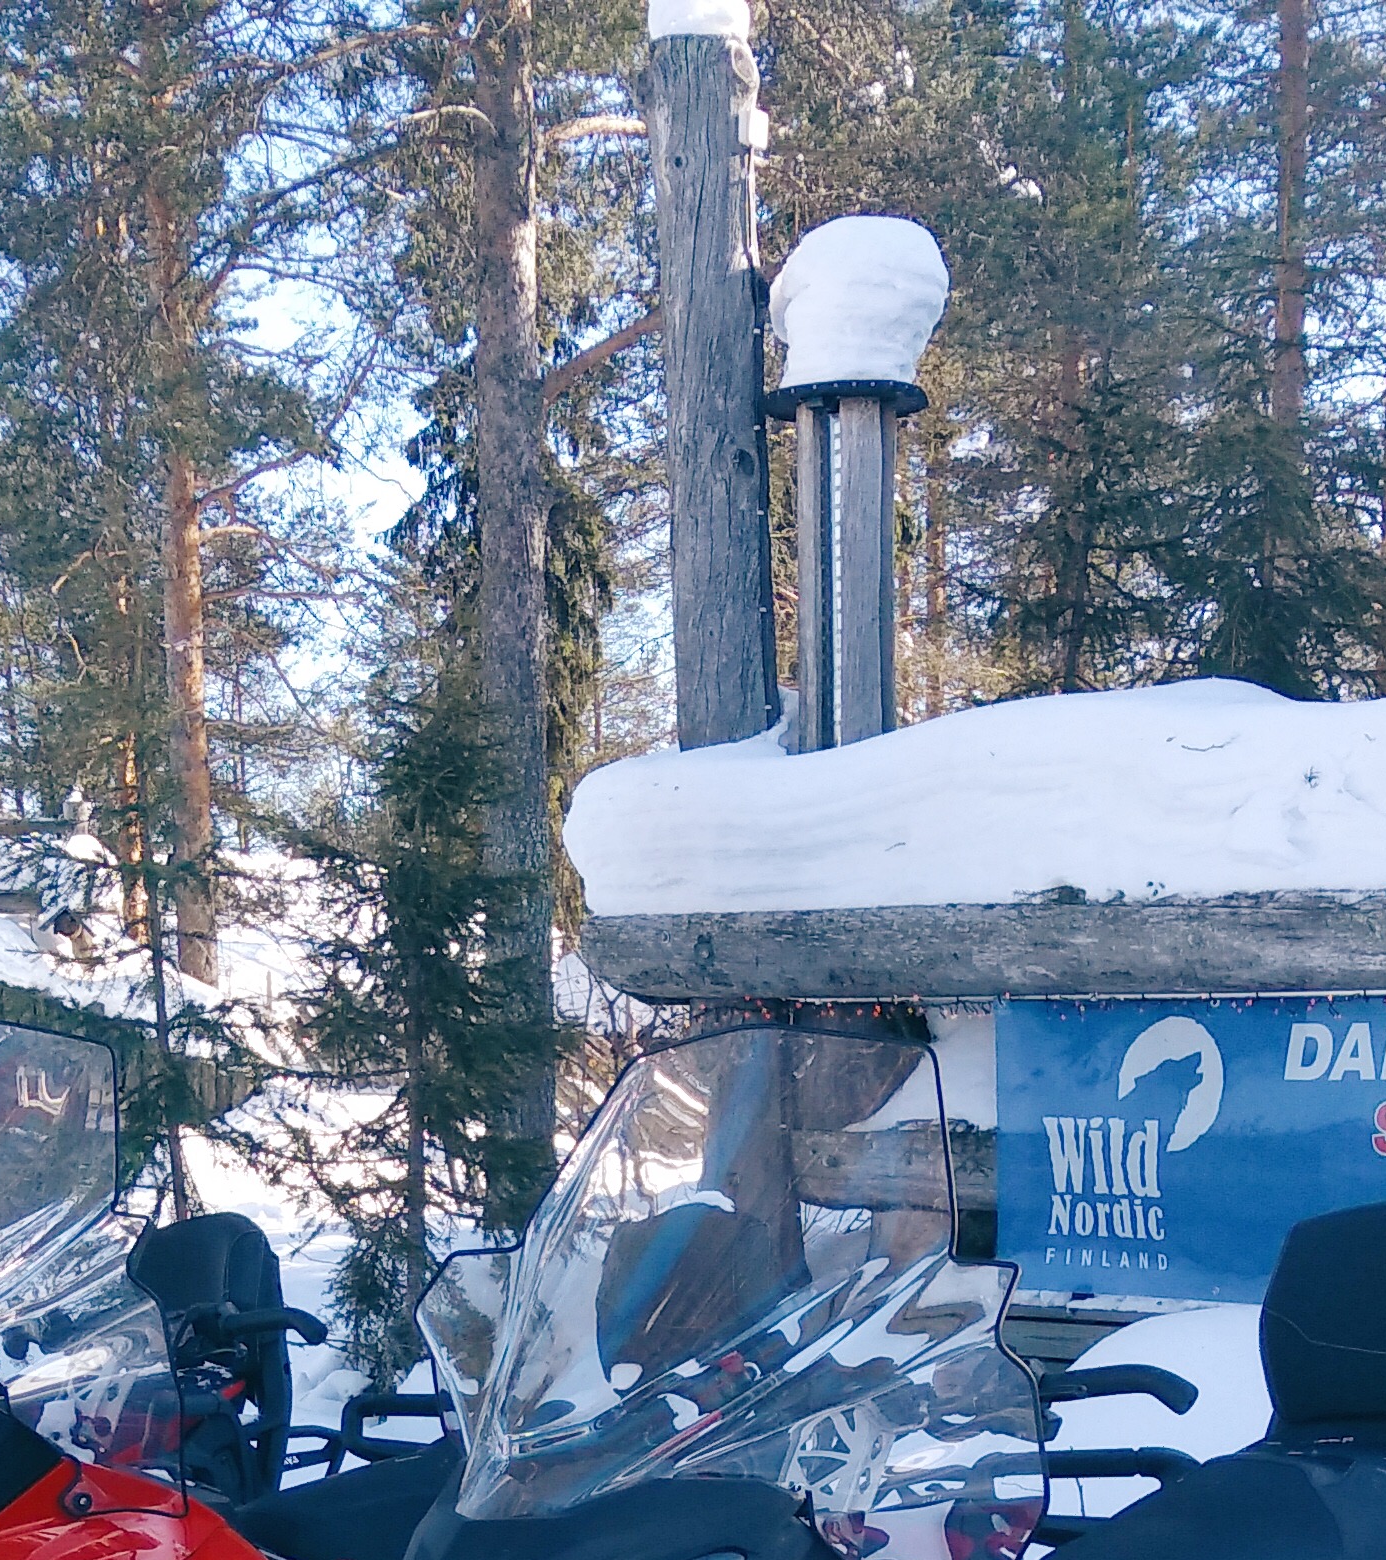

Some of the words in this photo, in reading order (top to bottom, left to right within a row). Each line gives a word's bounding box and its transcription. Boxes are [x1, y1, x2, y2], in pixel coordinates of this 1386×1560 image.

[1042, 1116, 1162, 1198] Wild
[1047, 1194, 1166, 1241] Nordic
[1045, 1247, 1169, 1271] FINLAND
